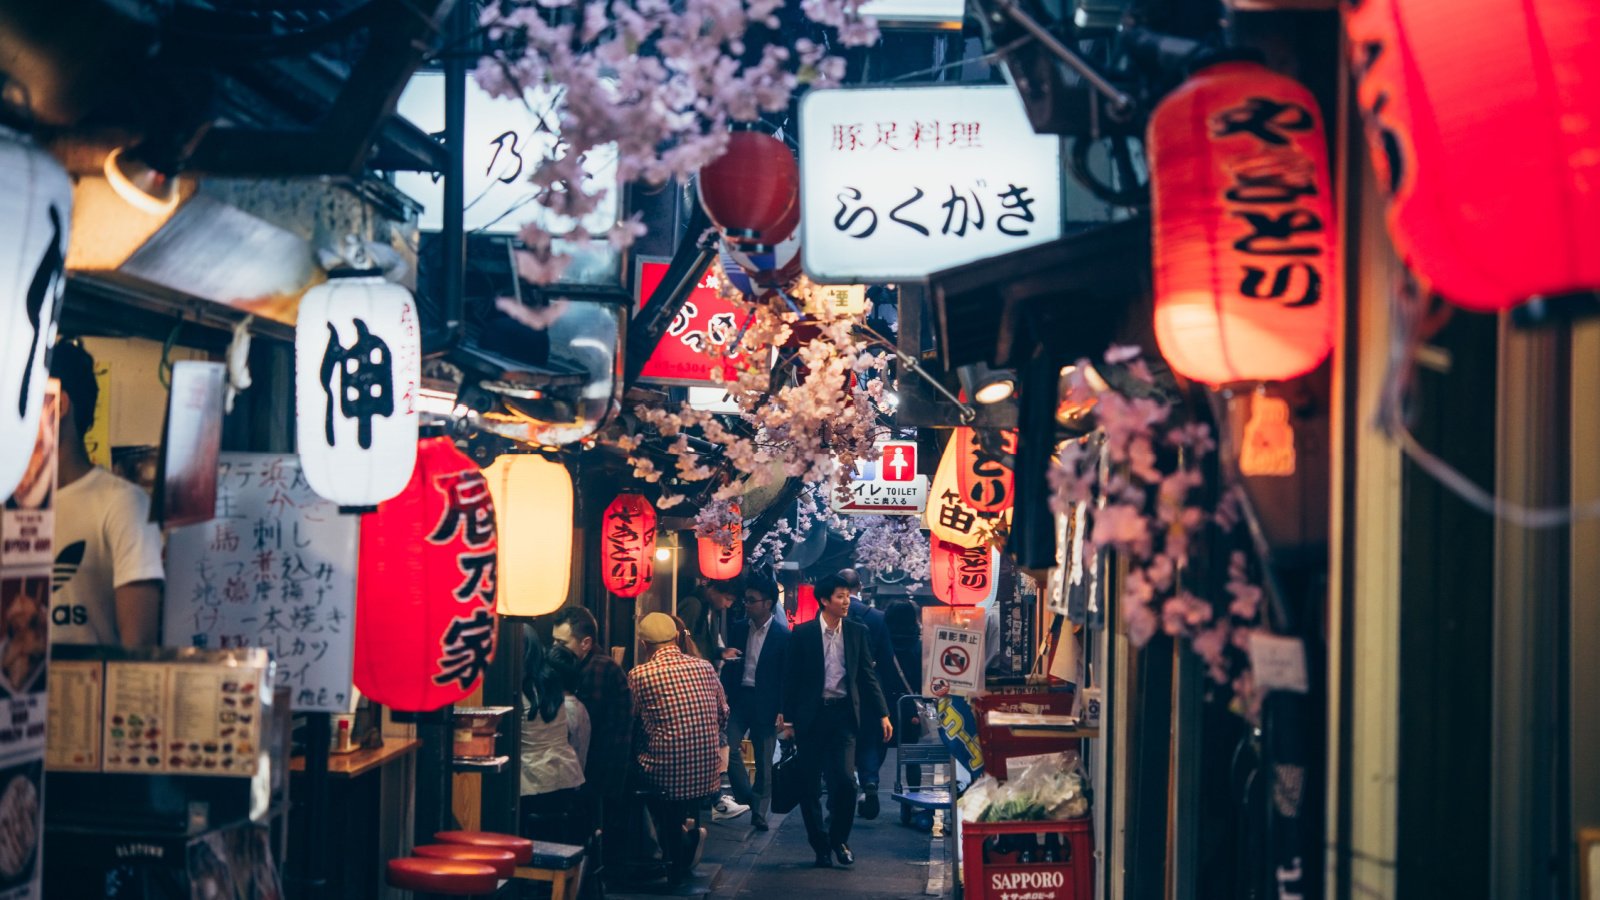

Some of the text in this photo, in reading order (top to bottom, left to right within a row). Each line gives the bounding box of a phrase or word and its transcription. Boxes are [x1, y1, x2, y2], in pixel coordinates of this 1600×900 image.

[831, 120, 984, 151] 豚足料理
[834, 178, 1036, 239] らくがき
[319, 316, 395, 451] 伸
[886, 487, 917, 496] TOILET
[939, 630, 978, 645] 撮影禁止
[992, 871, 1064, 889] SAPPORO
